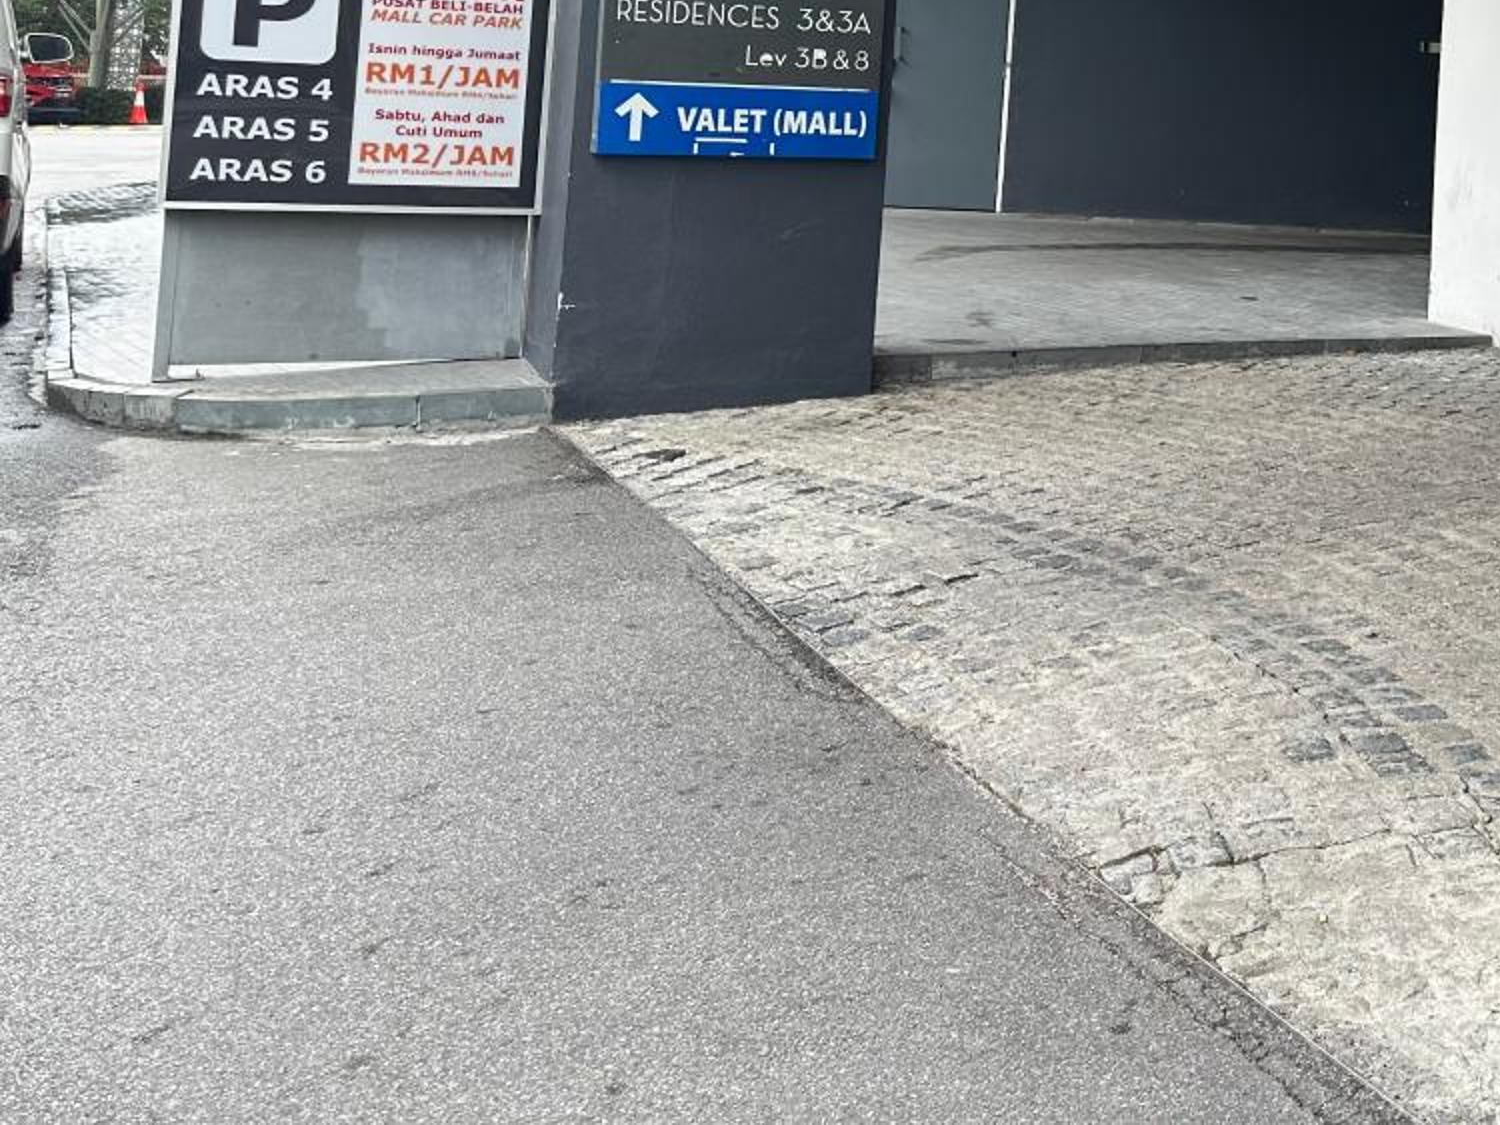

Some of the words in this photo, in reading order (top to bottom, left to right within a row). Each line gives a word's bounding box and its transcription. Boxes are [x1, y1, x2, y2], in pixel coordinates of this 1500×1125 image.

[370, 9, 422, 24] MALL
[429, 12, 466, 26] CAR
[472, 15, 523, 29] PARK
[430, 0, 523, 14] BELI-BELAH
[796, 7, 871, 35] 3&3A
[368, 43, 407, 55] Isnin
[412, 45, 463, 60] hingga
[467, 48, 521, 60] Jumaat
[744, 44, 787, 68] Lev
[196, 72, 299, 100] ARAS
[311, 77, 333, 101] 4
[365, 62, 521, 91] RM1/JAM
[193, 115, 295, 142] ARAS
[308, 119, 329, 142] 5
[375, 108, 426, 124] Sabtu,
[431, 111, 471, 123] Ahad
[475, 112, 505, 124] dan
[678, 106, 767, 134] VALET
[773, 108, 868, 137] (MALL)
[395, 125, 427, 137] Cuti
[432, 126, 483, 138] Umum
[358, 142, 514, 168] RM2/JAM
[189, 157, 293, 182] ARAS
[305, 160, 326, 184] 6
